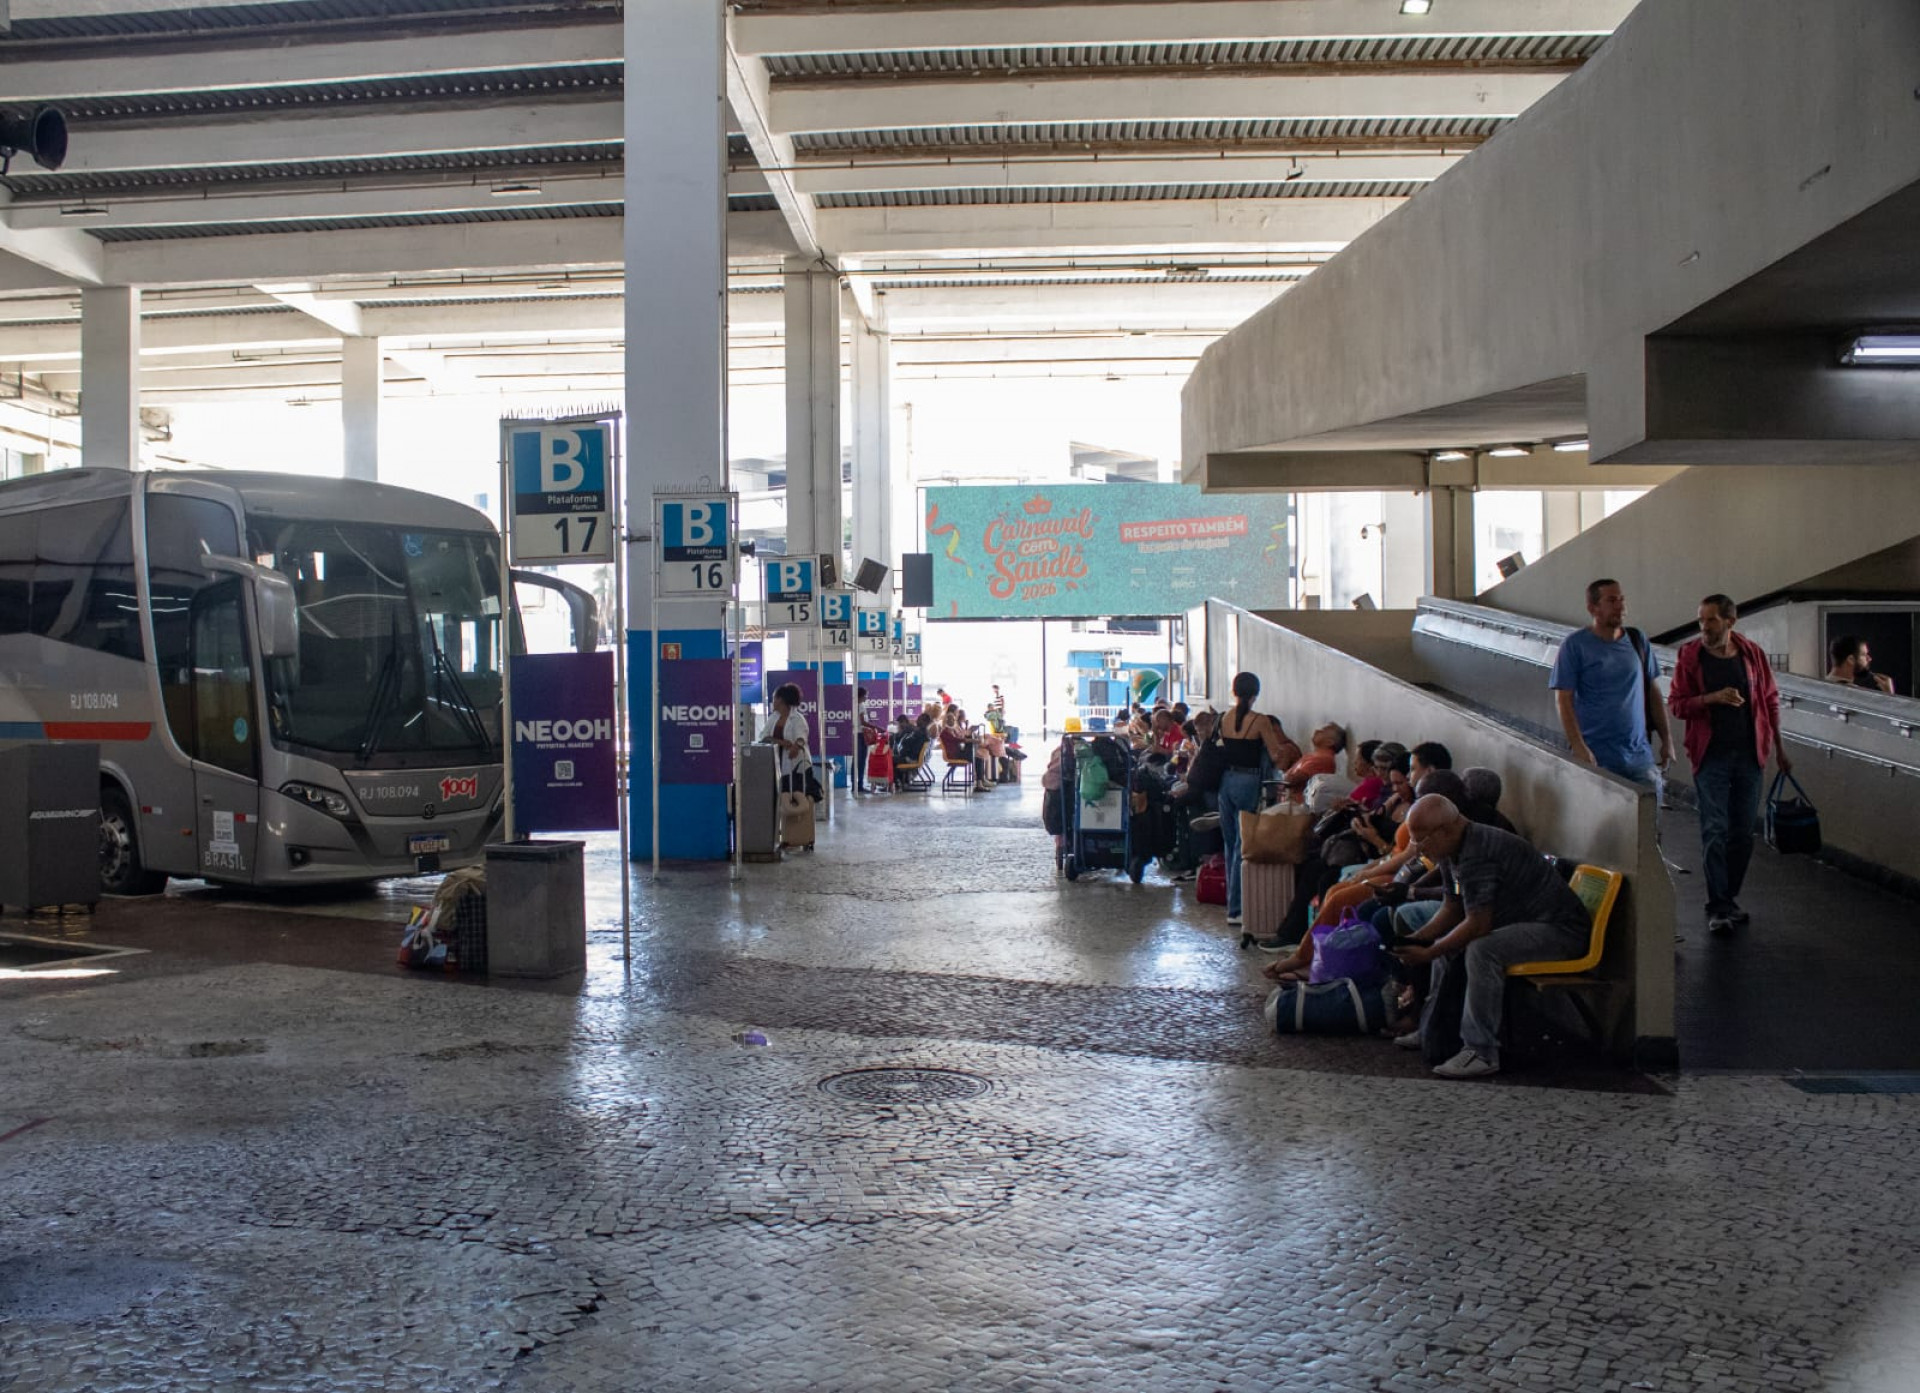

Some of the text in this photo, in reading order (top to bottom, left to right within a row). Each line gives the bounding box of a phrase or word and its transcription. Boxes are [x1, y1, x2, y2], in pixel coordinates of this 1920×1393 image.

[540, 431, 584, 492] B
[547, 494, 598, 505] Plataforma
[682, 503, 714, 547] B
[982, 507, 1094, 555] Carnaval
[1123, 516, 1244, 539] RESPEITO TAMBÉM
[554, 516, 598, 554] 17
[1021, 541, 1056, 556] com
[691, 563, 723, 589] 16
[780, 561, 802, 592] B
[989, 545, 1088, 598] Saúde
[787, 604, 809, 622] 15
[824, 594, 843, 620] B
[866, 612, 881, 632] B
[830, 630, 847, 645] 14
[870, 638, 884, 650] 13
[906, 635, 917, 650] B
[909, 654, 919, 663] 11
[71, 692, 119, 709] RJ 108.094
[662, 705, 730, 721] NEOOH
[822, 709, 852, 720] EOOH
[515, 719, 612, 743] NEOOH
[359, 785, 419, 800] RJ 108.094
[440, 773, 477, 800] 1001
[205, 851, 246, 870] BRASIL
